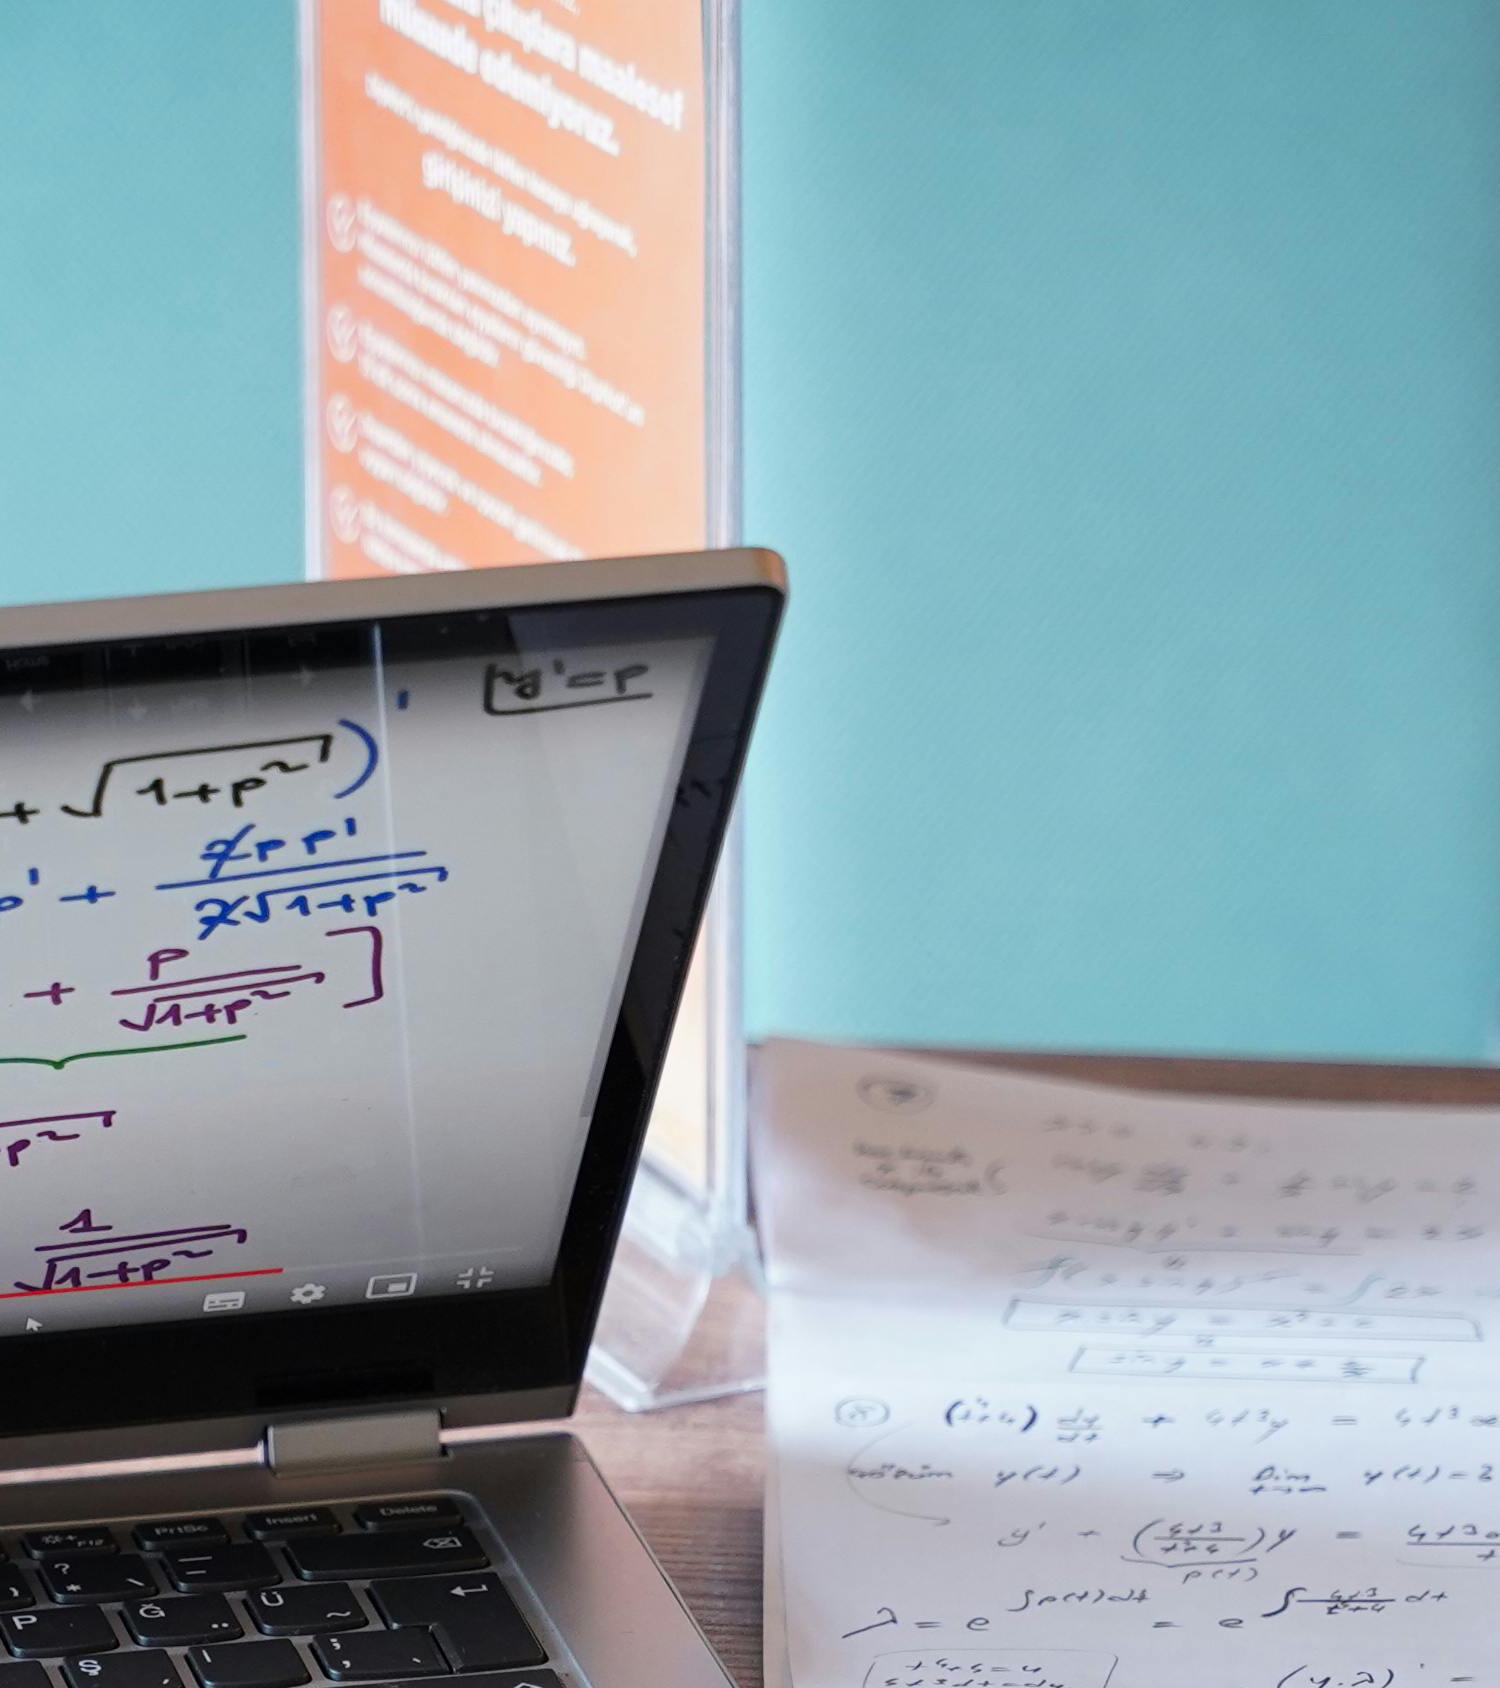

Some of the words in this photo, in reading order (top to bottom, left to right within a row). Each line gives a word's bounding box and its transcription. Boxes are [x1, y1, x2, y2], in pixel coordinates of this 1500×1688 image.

[264, 1512, 319, 1527] Insert
[379, 1502, 439, 1517] Delete
[12, 1613, 40, 1632] P
